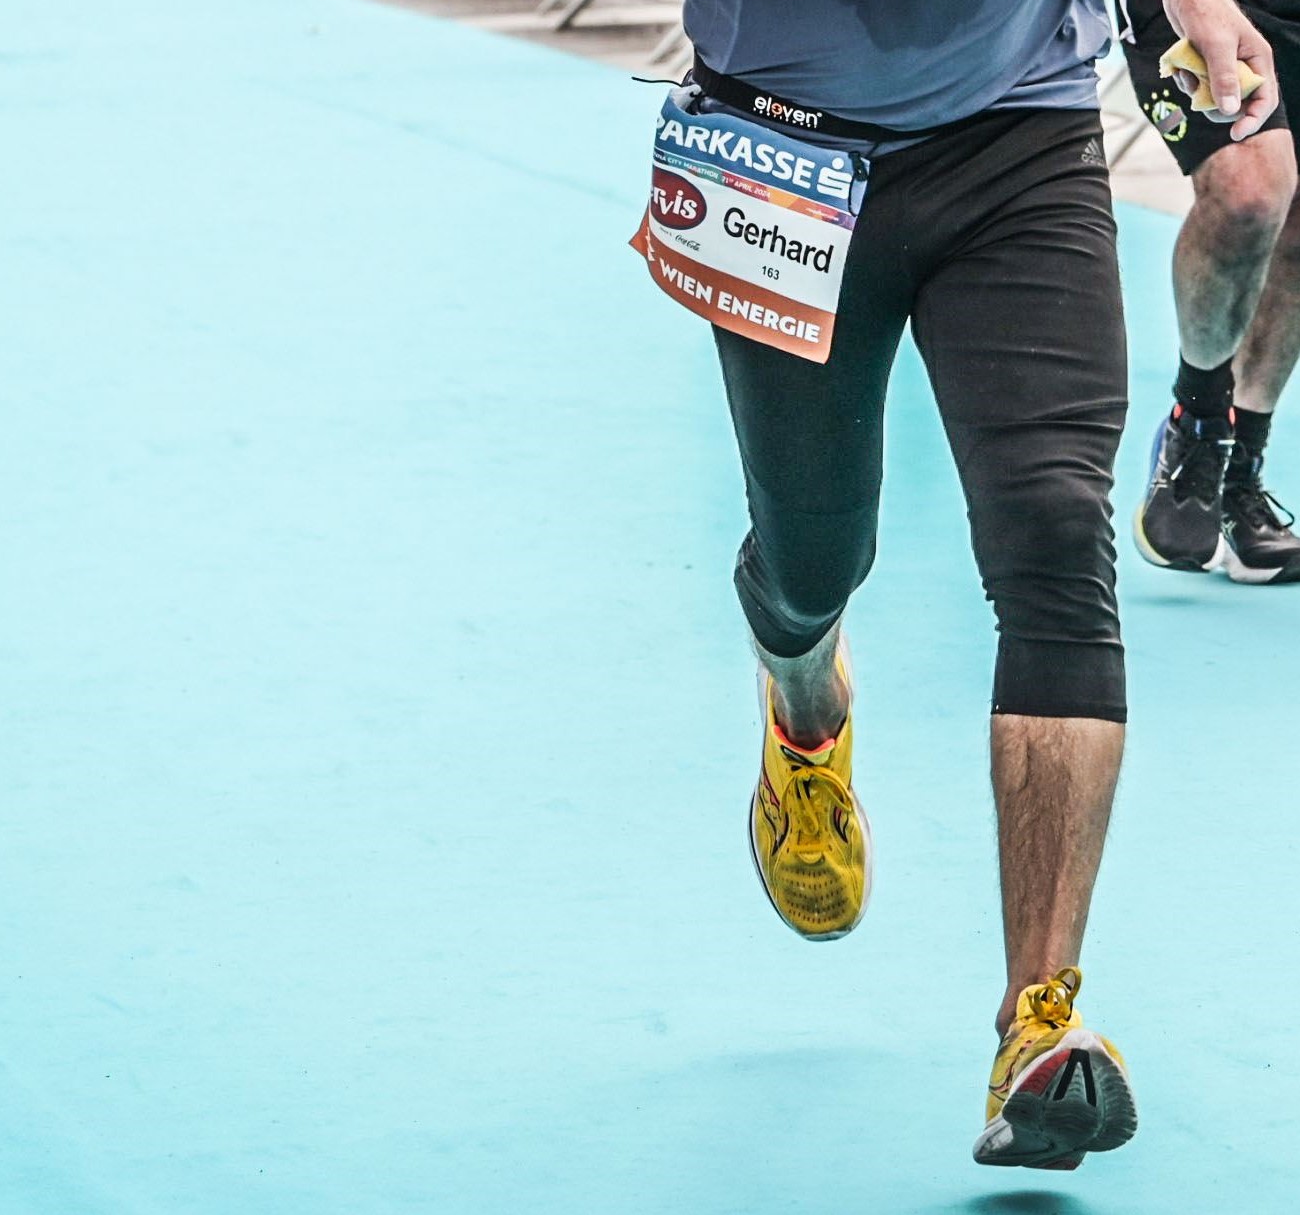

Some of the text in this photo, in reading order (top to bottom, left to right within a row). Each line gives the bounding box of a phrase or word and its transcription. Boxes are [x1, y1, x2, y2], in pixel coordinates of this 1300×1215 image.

[656, 116, 816, 189] ARKASSE
[723, 207, 834, 274] Gerhard
[761, 265, 780, 281] 163
[659, 257, 821, 344] WIEN ENERGIE
